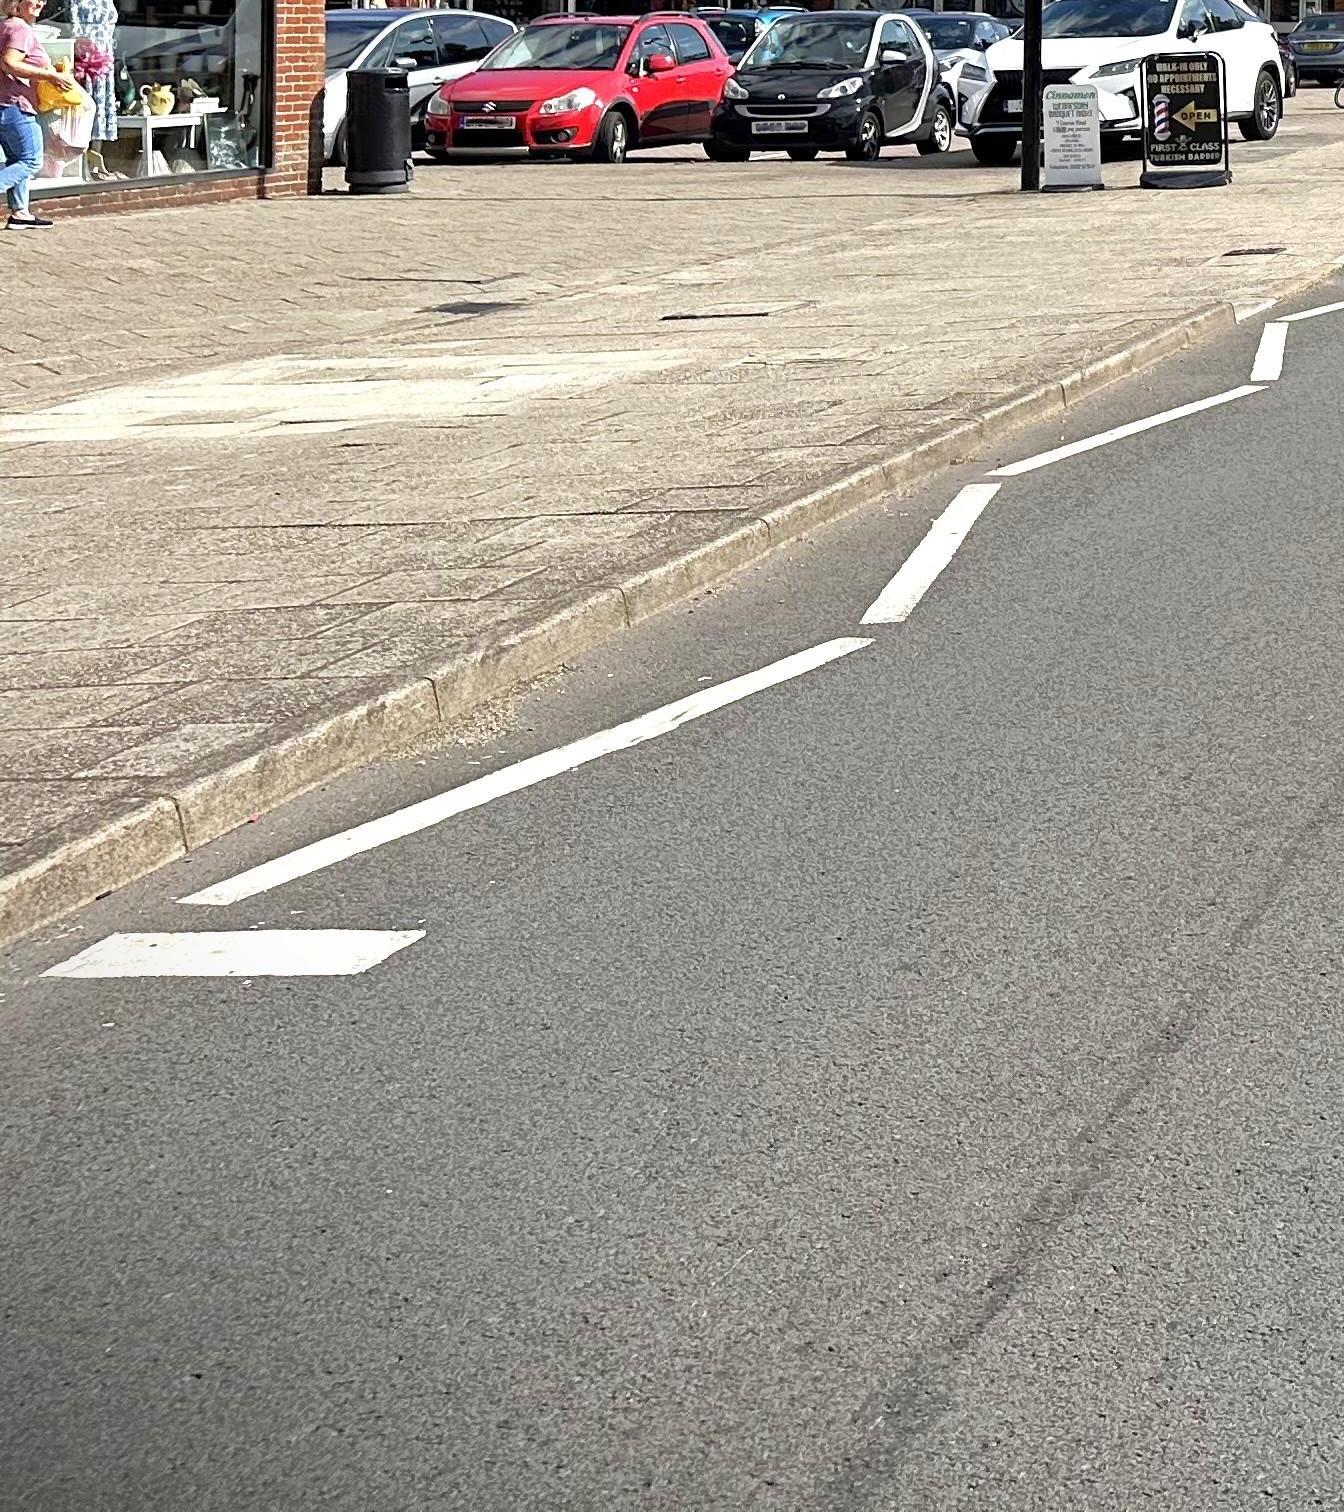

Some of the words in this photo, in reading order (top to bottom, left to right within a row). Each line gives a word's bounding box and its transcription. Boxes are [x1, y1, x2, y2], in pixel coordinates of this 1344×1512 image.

[1181, 112, 1211, 121] OPEN
[1150, 143, 1177, 152] FIRST
[1190, 142, 1220, 151] CLASS
[1150, 153, 1186, 161] TURKISH
